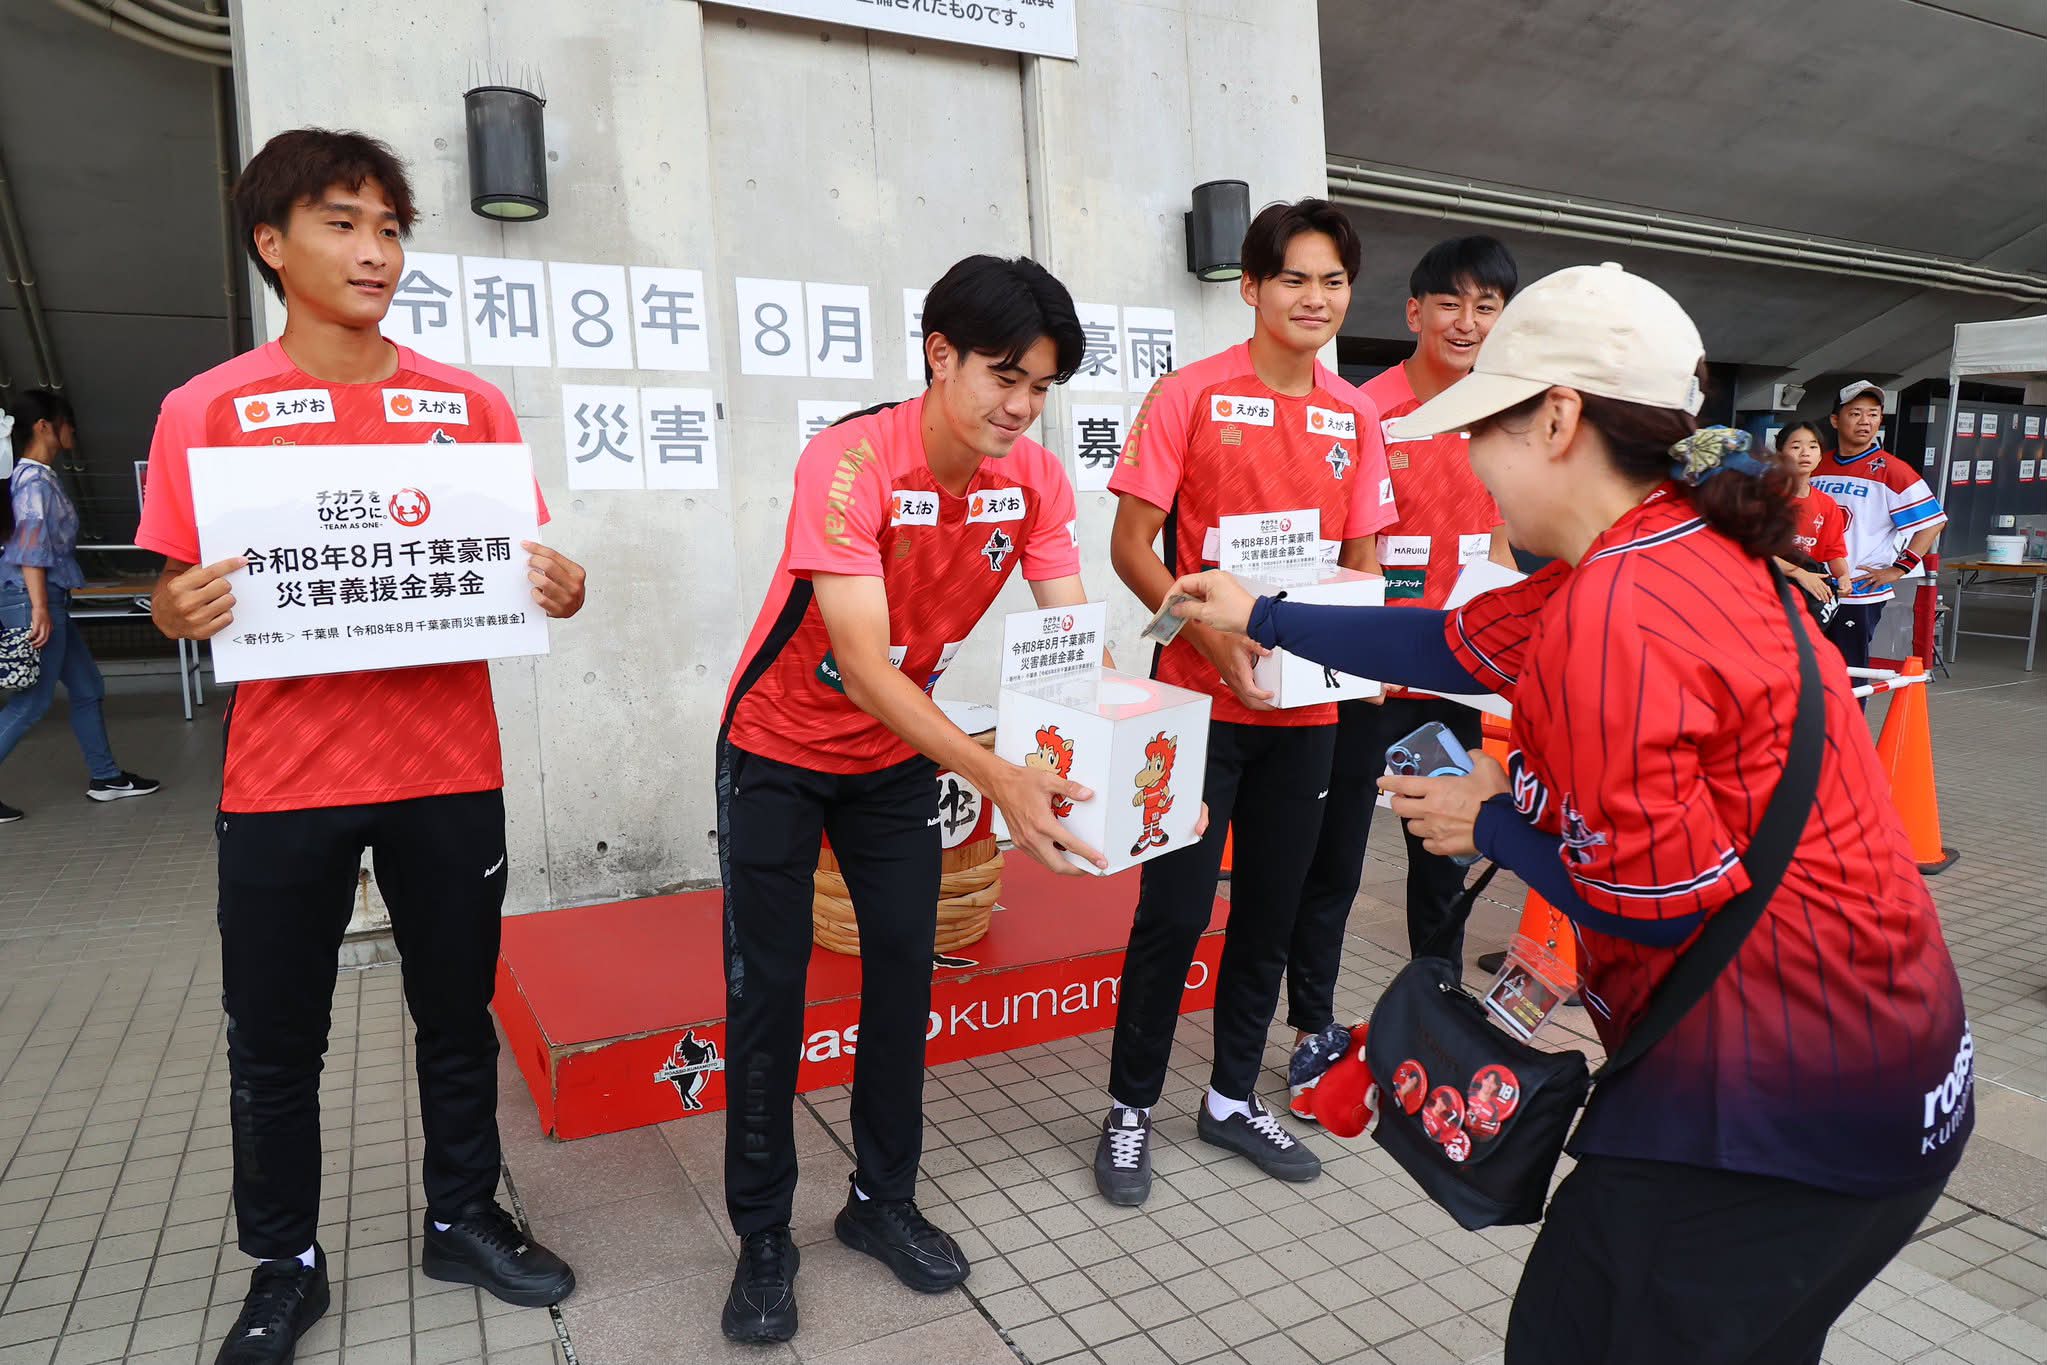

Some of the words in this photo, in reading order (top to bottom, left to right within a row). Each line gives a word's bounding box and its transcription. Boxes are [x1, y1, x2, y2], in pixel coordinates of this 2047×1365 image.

[391, 269, 700, 348] 令和8年
[753, 302, 862, 363] 8月
[275, 397, 326, 417] えがお
[418, 398, 462, 416] えがお
[1235, 403, 1270, 418] えがお
[573, 402, 709, 464] 災害
[1327, 416, 1355, 432] えがお
[316, 489, 381, 505] チカラを
[824, 438, 877, 546] Admiral
[317, 505, 388, 522] ひとつに。
[1231, 531, 1314, 550] 令和8年8月千葉豪雨
[241, 536, 512, 576] 令和8年8月千葉豪雨
[276, 570, 486, 609] 災害義援金募金
[1011, 631, 1096, 656] 令和8年8月千葉豪雨
[1020, 648, 1085, 671] 災害義援金募金
[1498, 1082, 1514, 1100] 18
